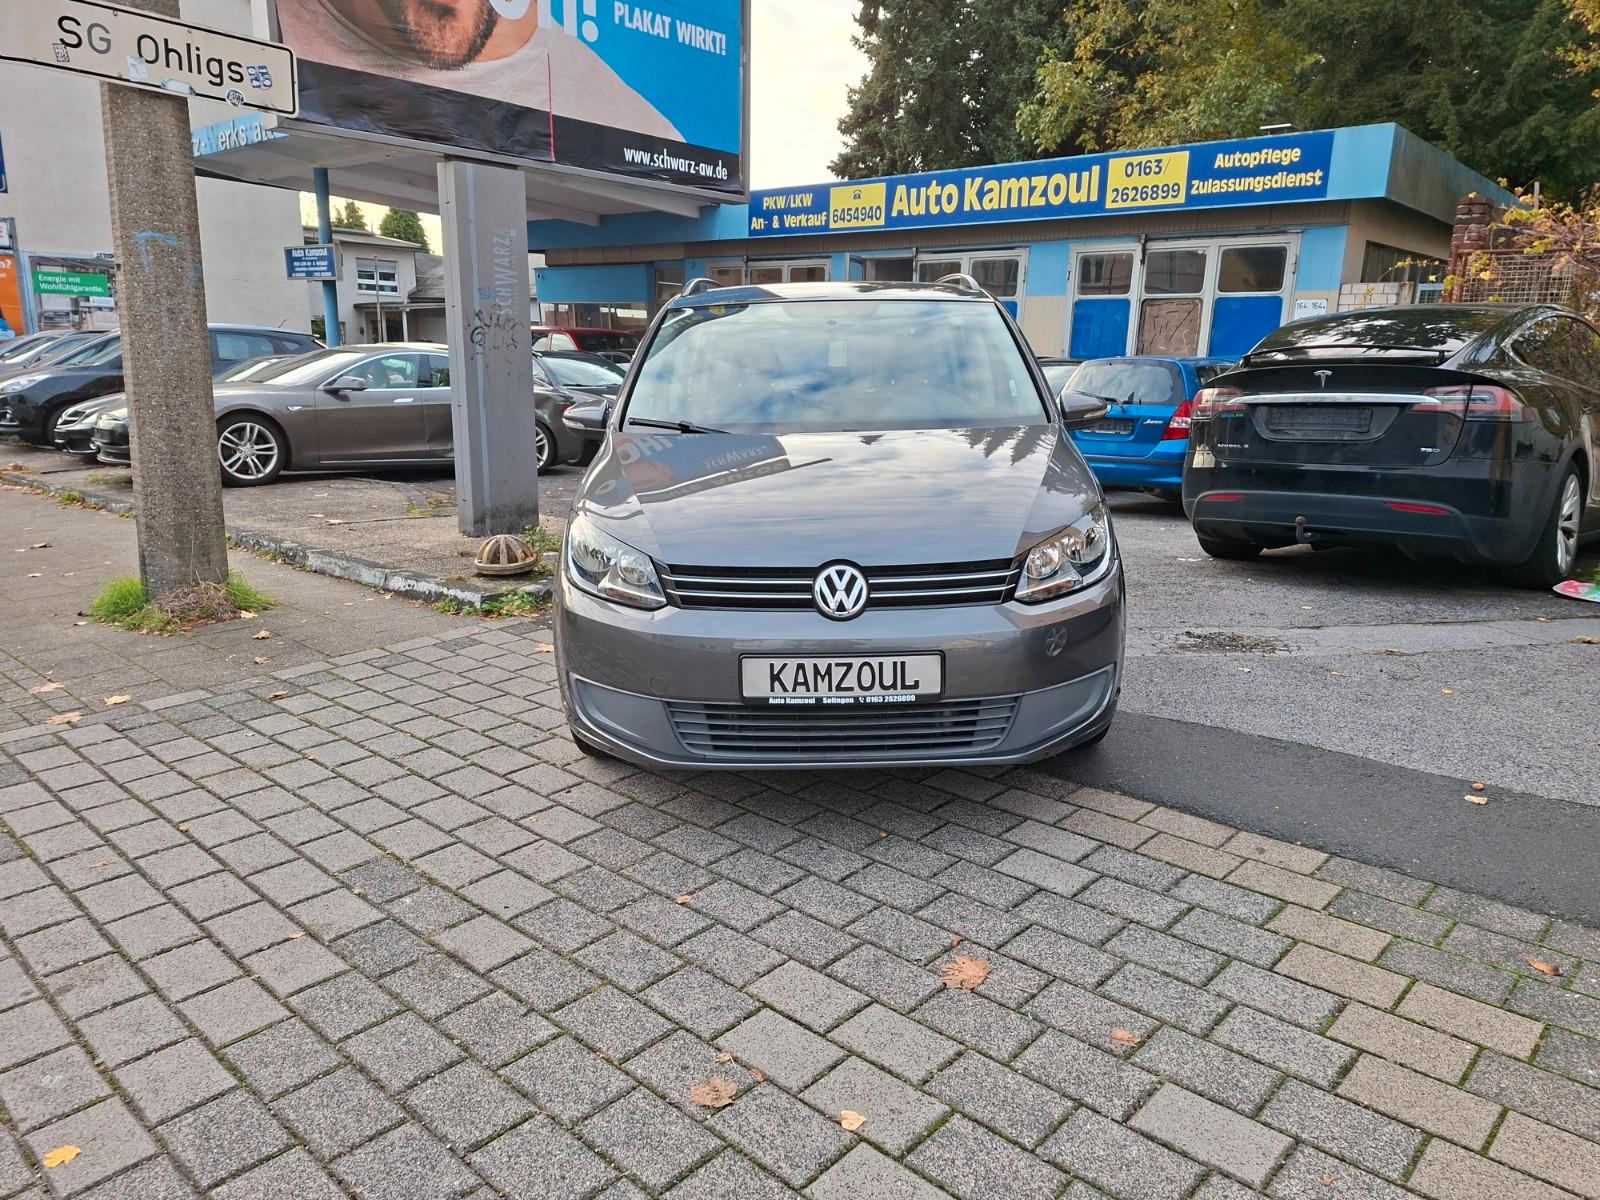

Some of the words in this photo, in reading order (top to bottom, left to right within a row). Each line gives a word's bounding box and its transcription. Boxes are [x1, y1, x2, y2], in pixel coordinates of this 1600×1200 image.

[614, 1, 672, 39] PLAKAT
[676, 20, 726, 56] WIRKT!
[57, 15, 112, 55] SG
[136, 34, 244, 87] Ohligs
[624, 147, 728, 180] www.schwarz-aw.de
[1214, 147, 1301, 170] Autopflege
[891, 180, 959, 217] Auto
[963, 165, 1101, 212] Kamzoul
[1190, 168, 1323, 195] Zulassungsdienst
[763, 193, 813, 210] PKW/LKW
[1110, 182, 1181, 204] 2626899
[751, 216, 769, 230] An-
[772, 215, 780, 228] &
[784, 211, 827, 228] Verkauf
[832, 205, 882, 224] 6454940
[39, 274, 67, 283] Energie
[68, 275, 81, 283] mit
[39, 282, 105, 293] Wohlfühlgarantie.
[769, 660, 920, 693] KAMZOUL
[768, 696, 785, 704] Auto
[786, 696, 815, 704] Kamzoul
[822, 696, 855, 705] Solingen
